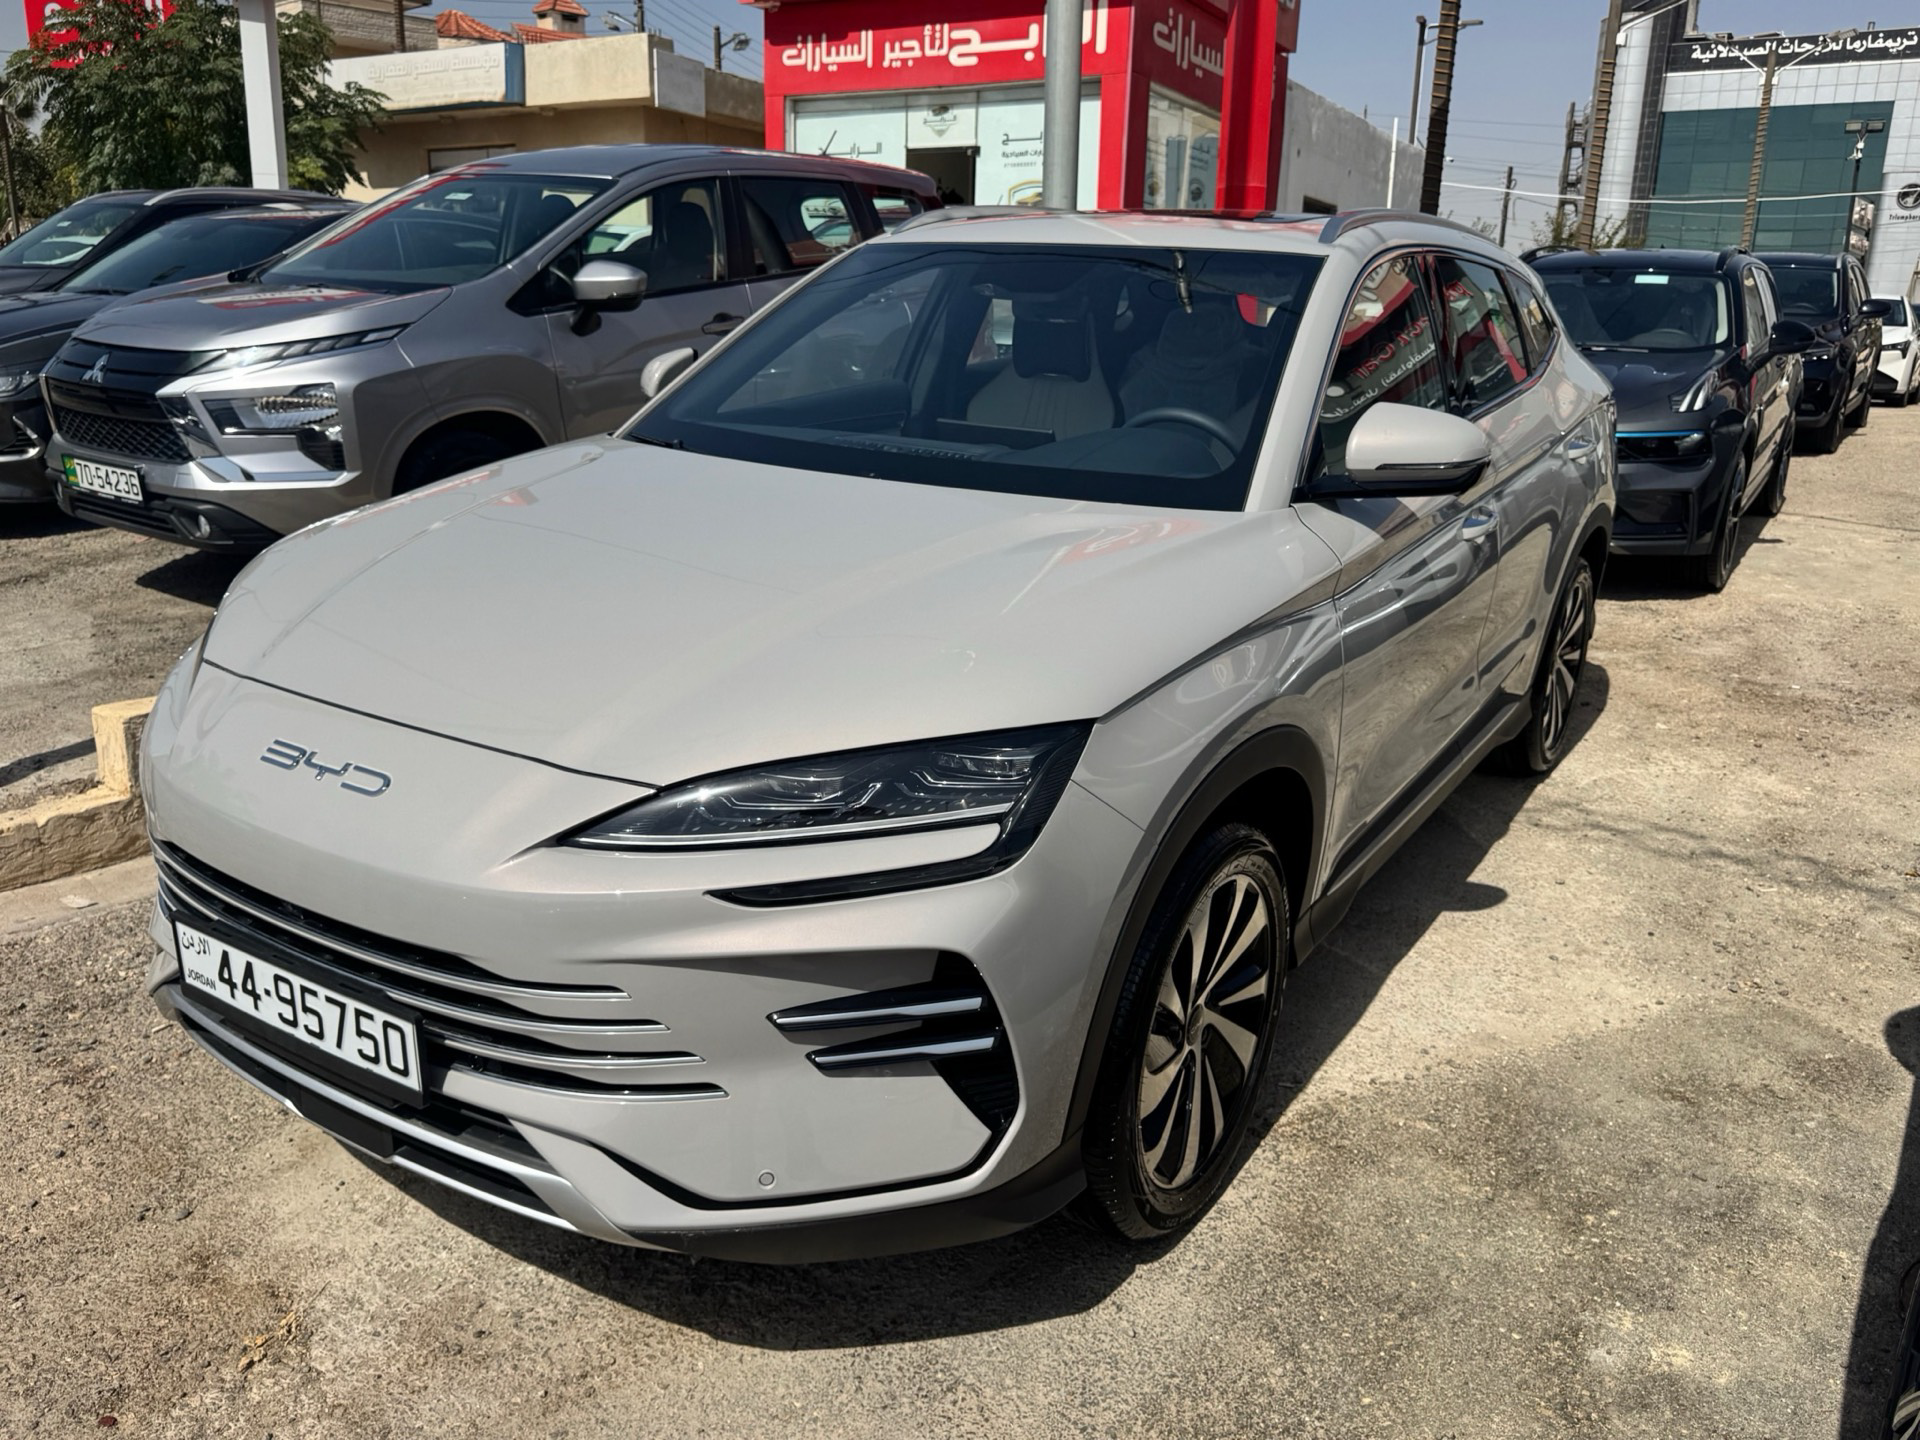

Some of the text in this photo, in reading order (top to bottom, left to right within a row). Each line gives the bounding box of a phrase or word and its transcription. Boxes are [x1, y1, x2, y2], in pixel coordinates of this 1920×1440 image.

[782, 29, 873, 72] السيارات
[882, 23, 949, 68] لتأجير
[76, 462, 139, 496] 70-54236
[260, 738, 392, 798] BYD
[187, 967, 216, 991] JORDAN
[218, 949, 410, 1077] 44-95750
